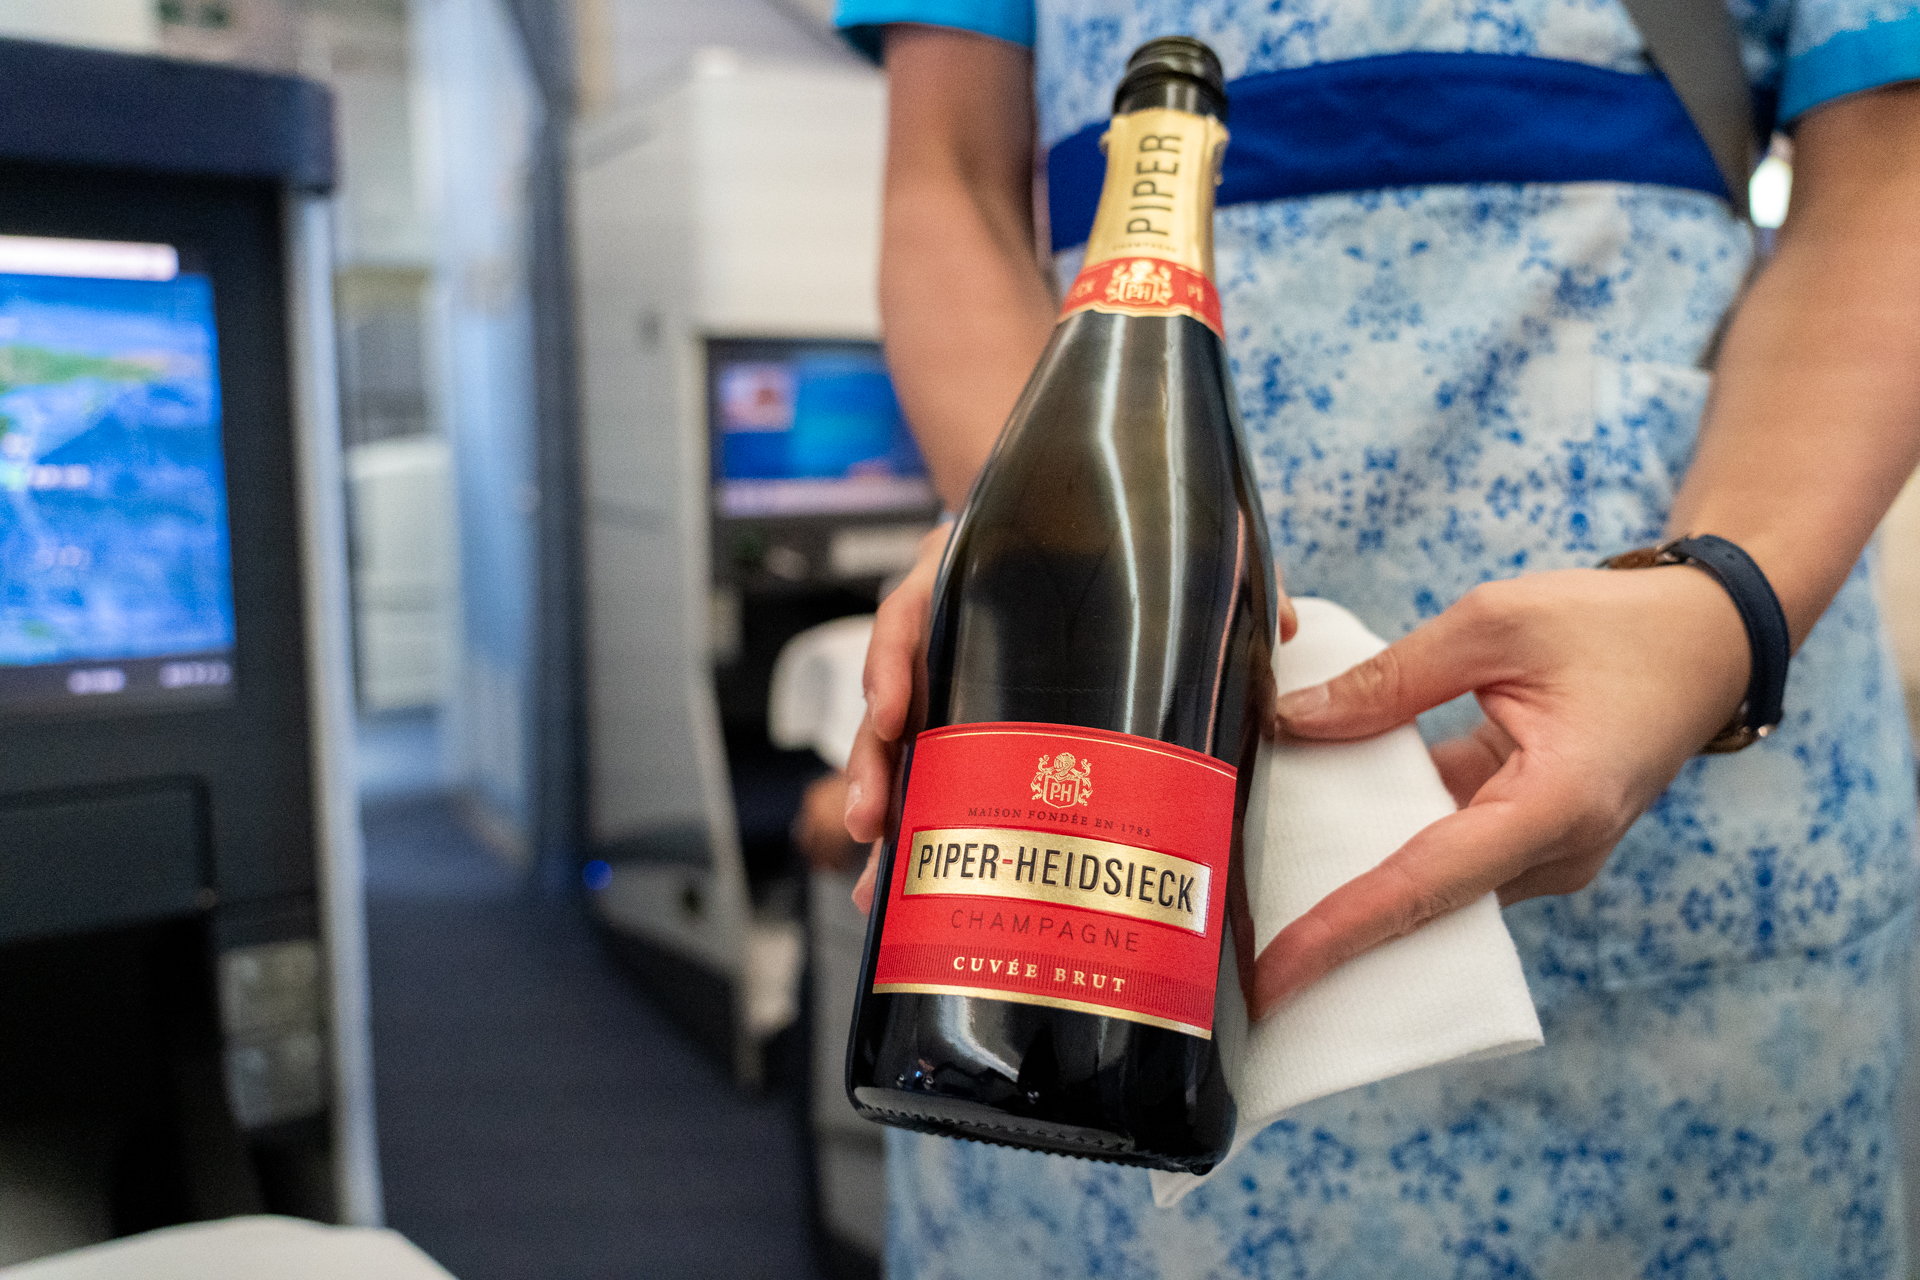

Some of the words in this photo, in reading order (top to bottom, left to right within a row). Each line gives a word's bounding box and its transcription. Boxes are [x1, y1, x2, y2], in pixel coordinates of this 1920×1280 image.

[1126, 134, 1183, 237] PIPER
[968, 807, 1022, 819] MAISON
[1028, 810, 1089, 826] FONDÉE
[1095, 817, 1114, 829] EN
[1120, 823, 1152, 837] 1785
[916, 842, 1196, 913] PIPER-HEIDSIECK
[951, 909, 1140, 952] CHAMPAGNE
[953, 955, 1038, 978] CUVÉE
[1054, 968, 1127, 992] BRUT
